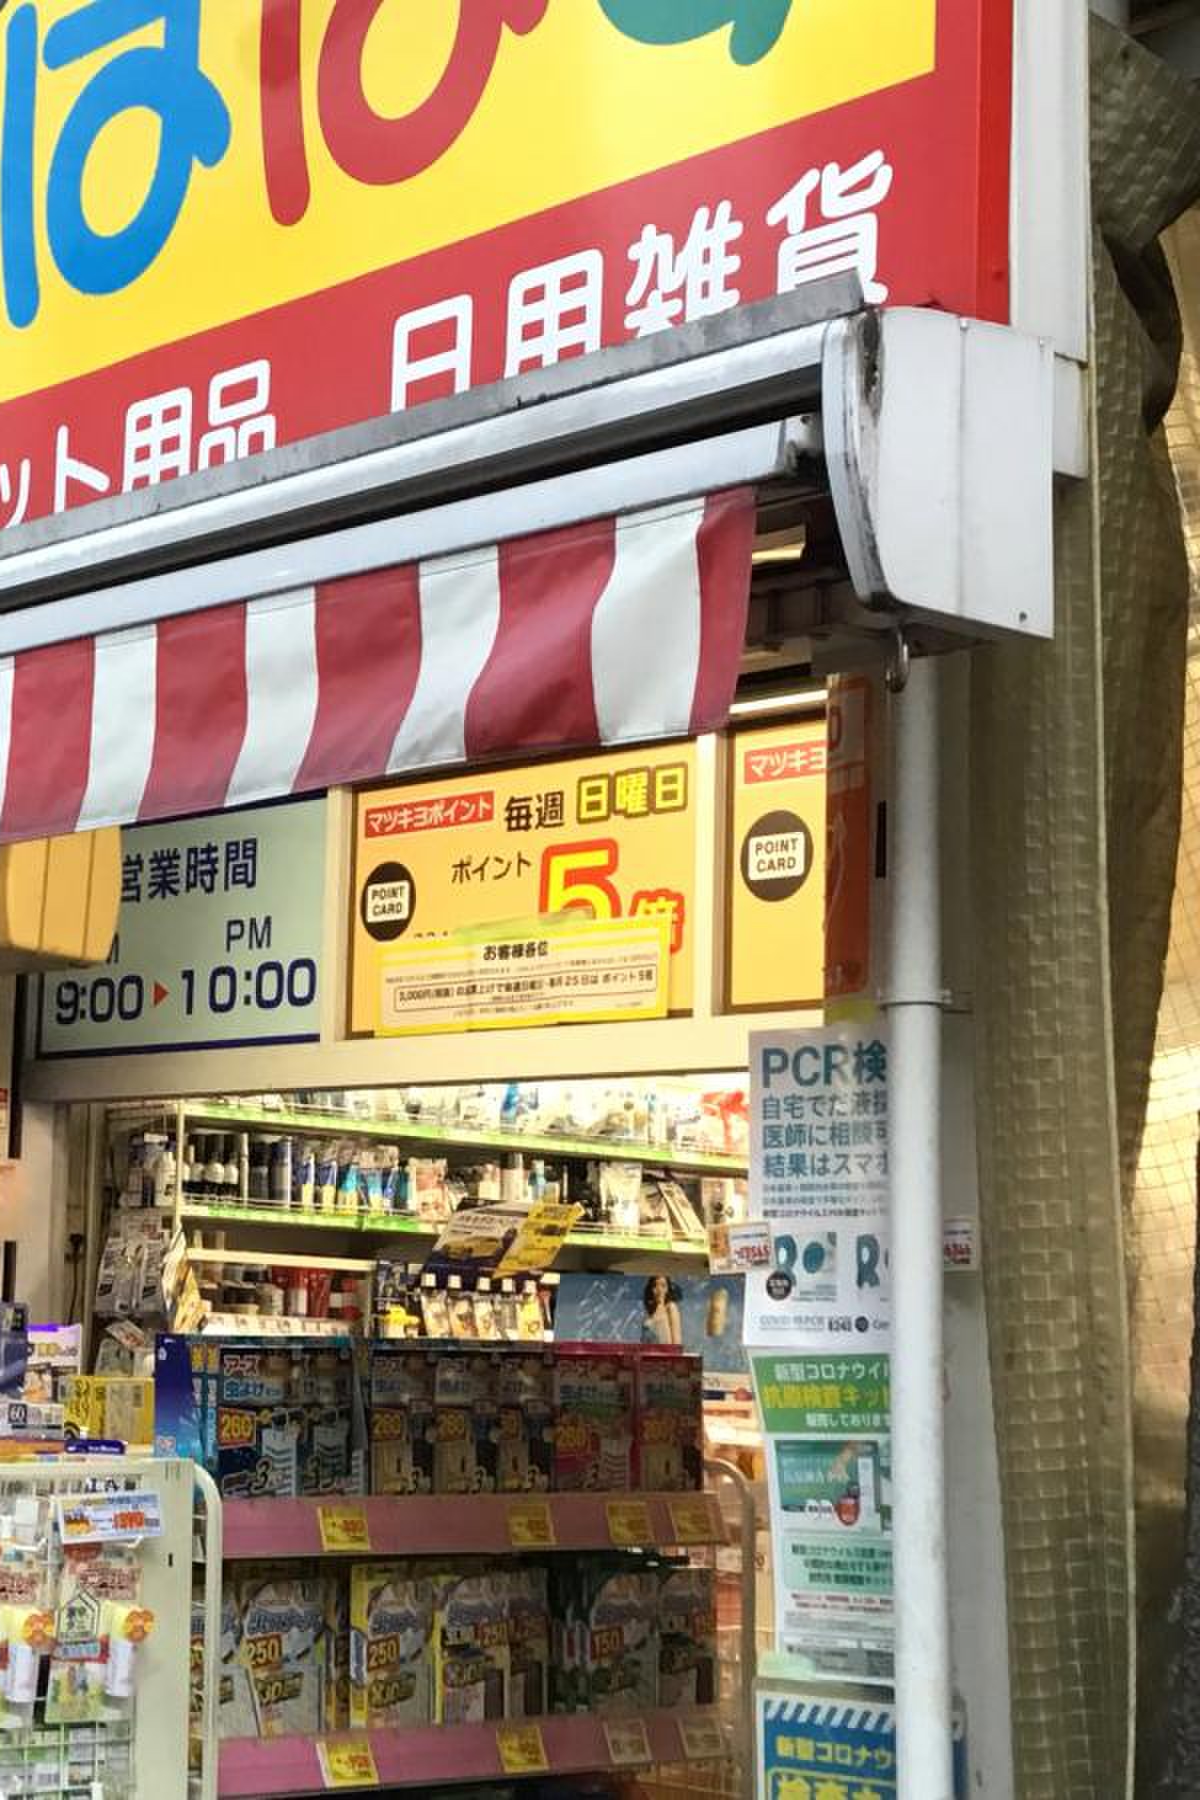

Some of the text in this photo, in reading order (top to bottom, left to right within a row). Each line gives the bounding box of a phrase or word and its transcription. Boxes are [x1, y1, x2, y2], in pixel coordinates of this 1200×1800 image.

[390, 148, 894, 413] 日用雑貨
[367, 762, 689, 833] マツキヨポイント 毎週 日曜日
[754, 838, 799, 857] POINT
[451, 851, 533, 885] ポイント
[756, 856, 797, 874] CARD
[371, 886, 405, 900] POINT
[372, 901, 404, 917] CARD
[226, 915, 272, 953] PM
[55, 957, 318, 1026] 9:00 10:00
[249, 1638, 278, 1664] 250
[369, 1641, 398, 1666] 250
